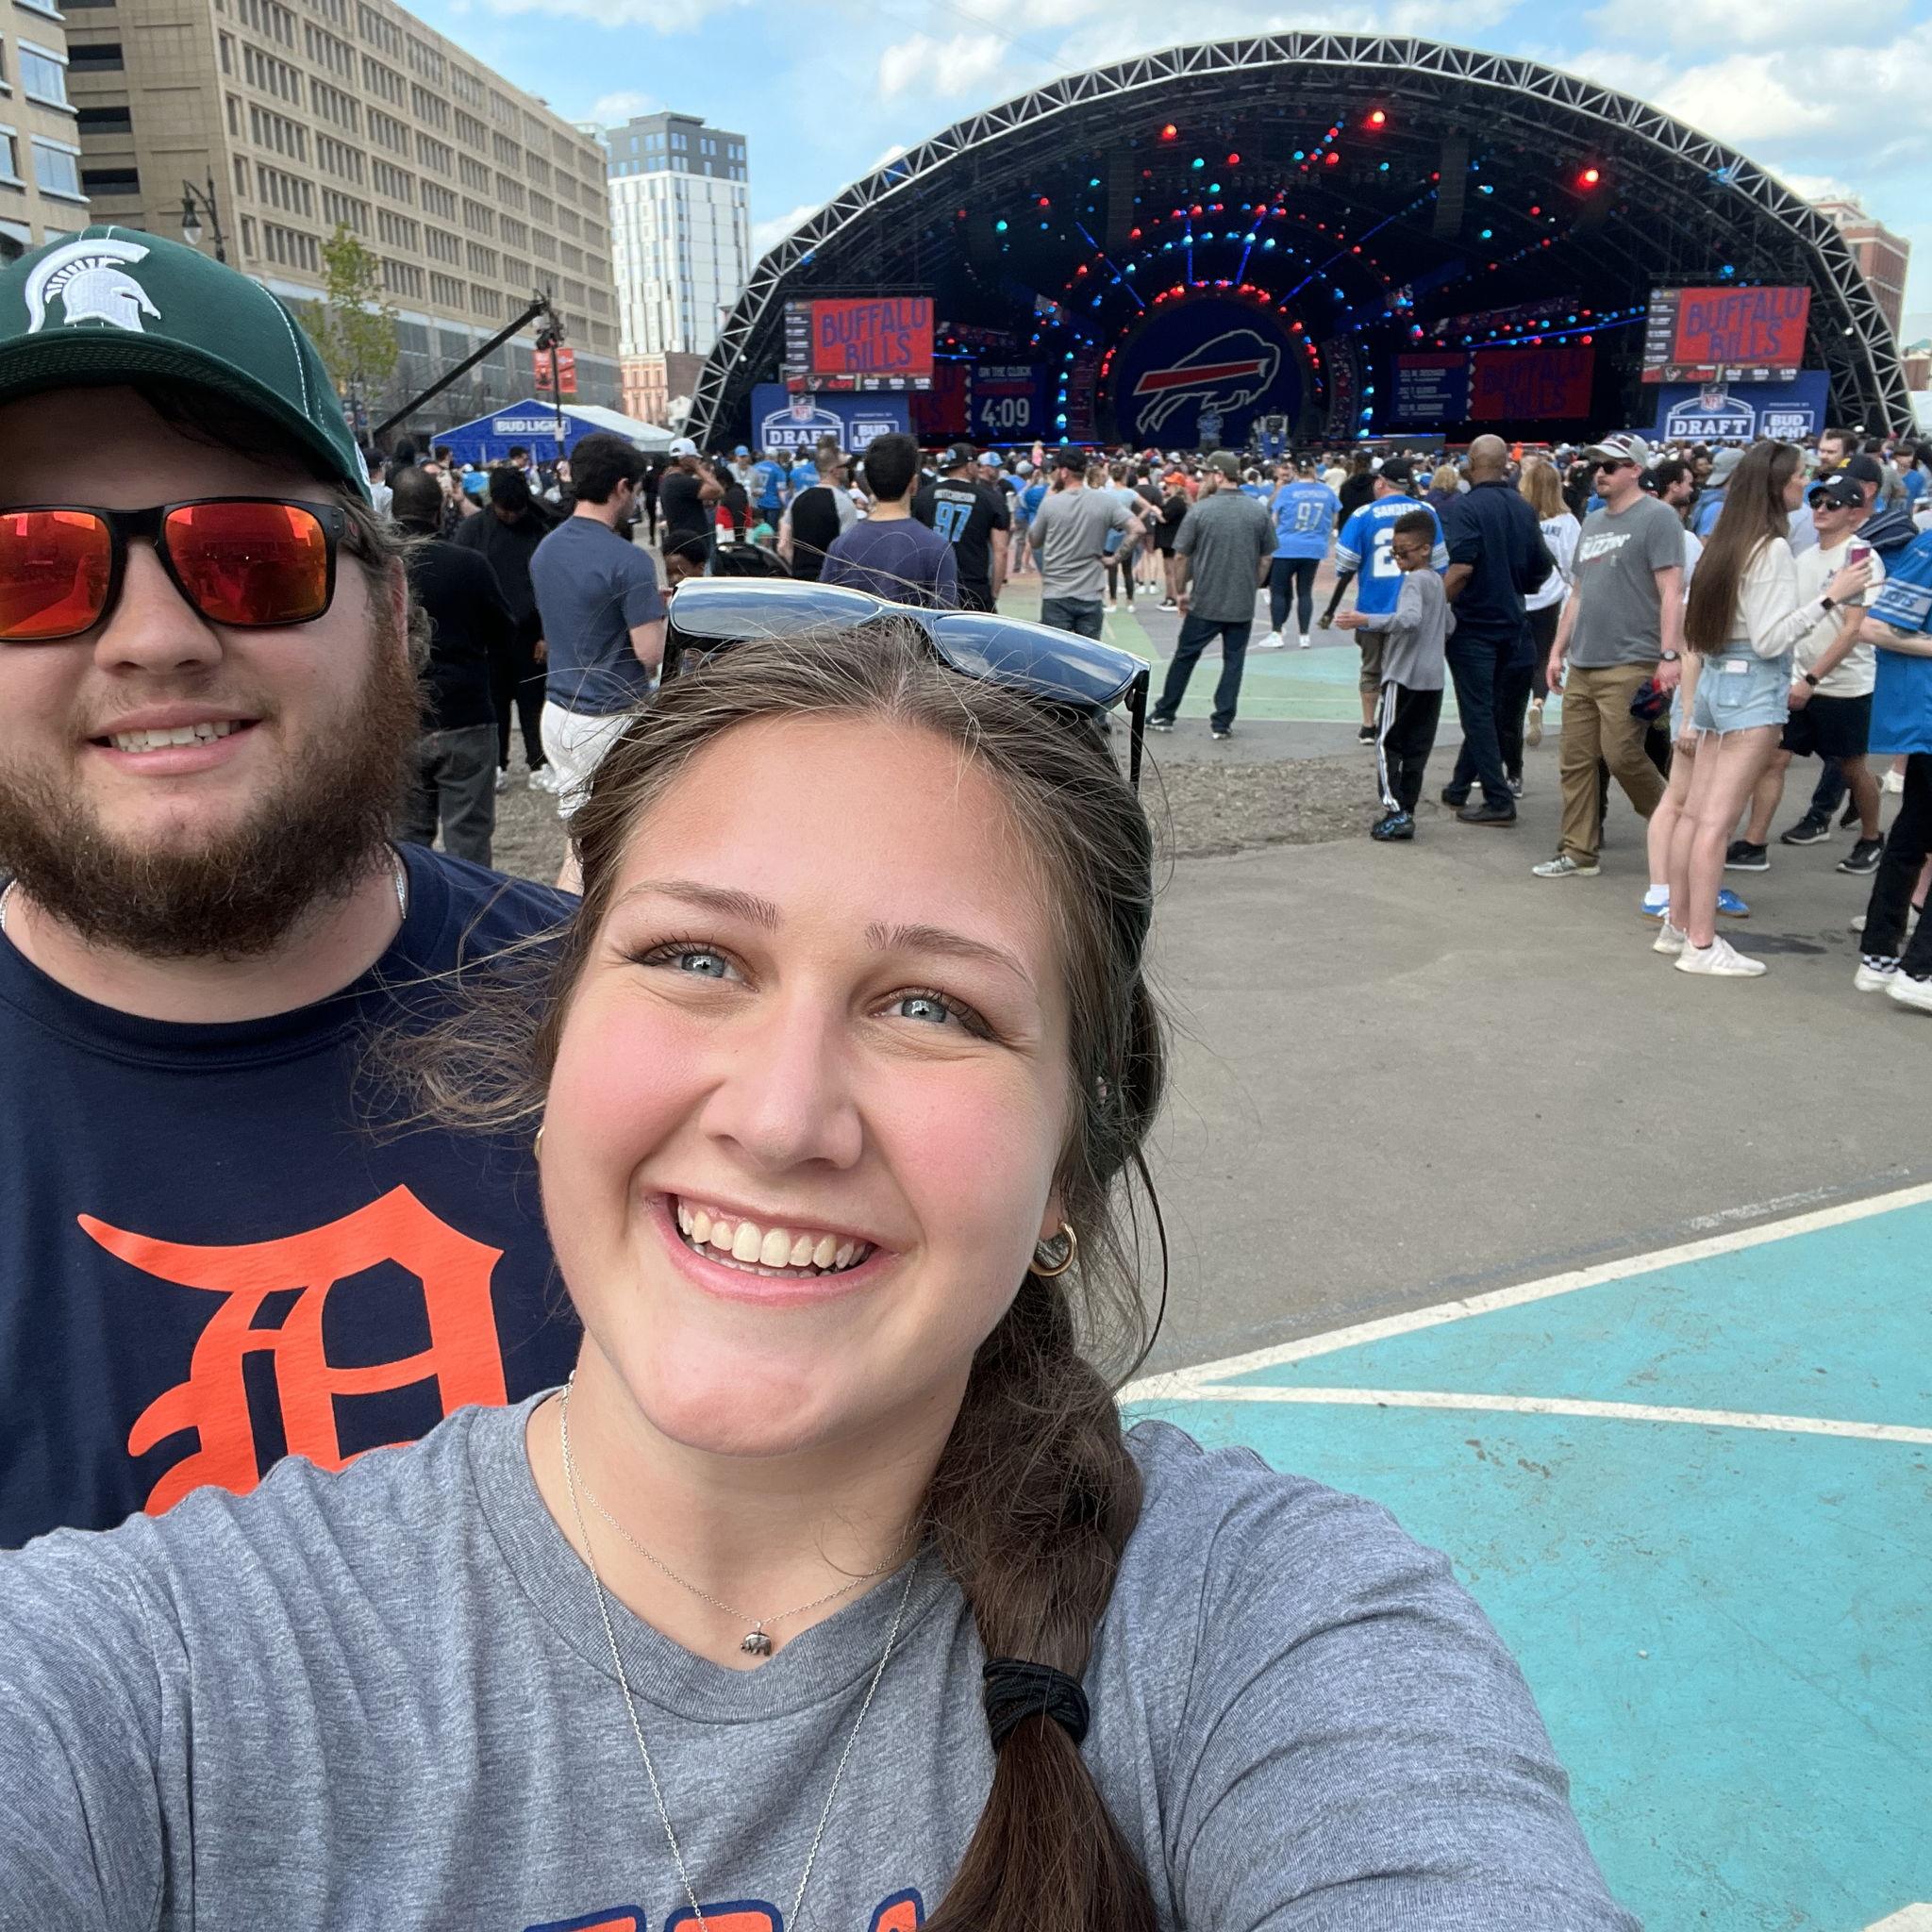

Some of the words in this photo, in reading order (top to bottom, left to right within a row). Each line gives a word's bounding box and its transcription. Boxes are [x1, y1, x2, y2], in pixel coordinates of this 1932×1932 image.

[822, 298, 925, 347] BUFFALO
[1686, 286, 1805, 337] BUFFALO
[845, 333, 911, 373] BILLS
[1707, 322, 1782, 363] BILLS
[496, 420, 525, 432] BUD
[981, 397, 1030, 427] 4:09
[1770, 414, 1805, 425] BUD
[858, 425, 891, 436] BUD
[1673, 420, 1747, 435] DRAFT
[933, 501, 973, 542] 97
[1294, 502, 1324, 532] 97
